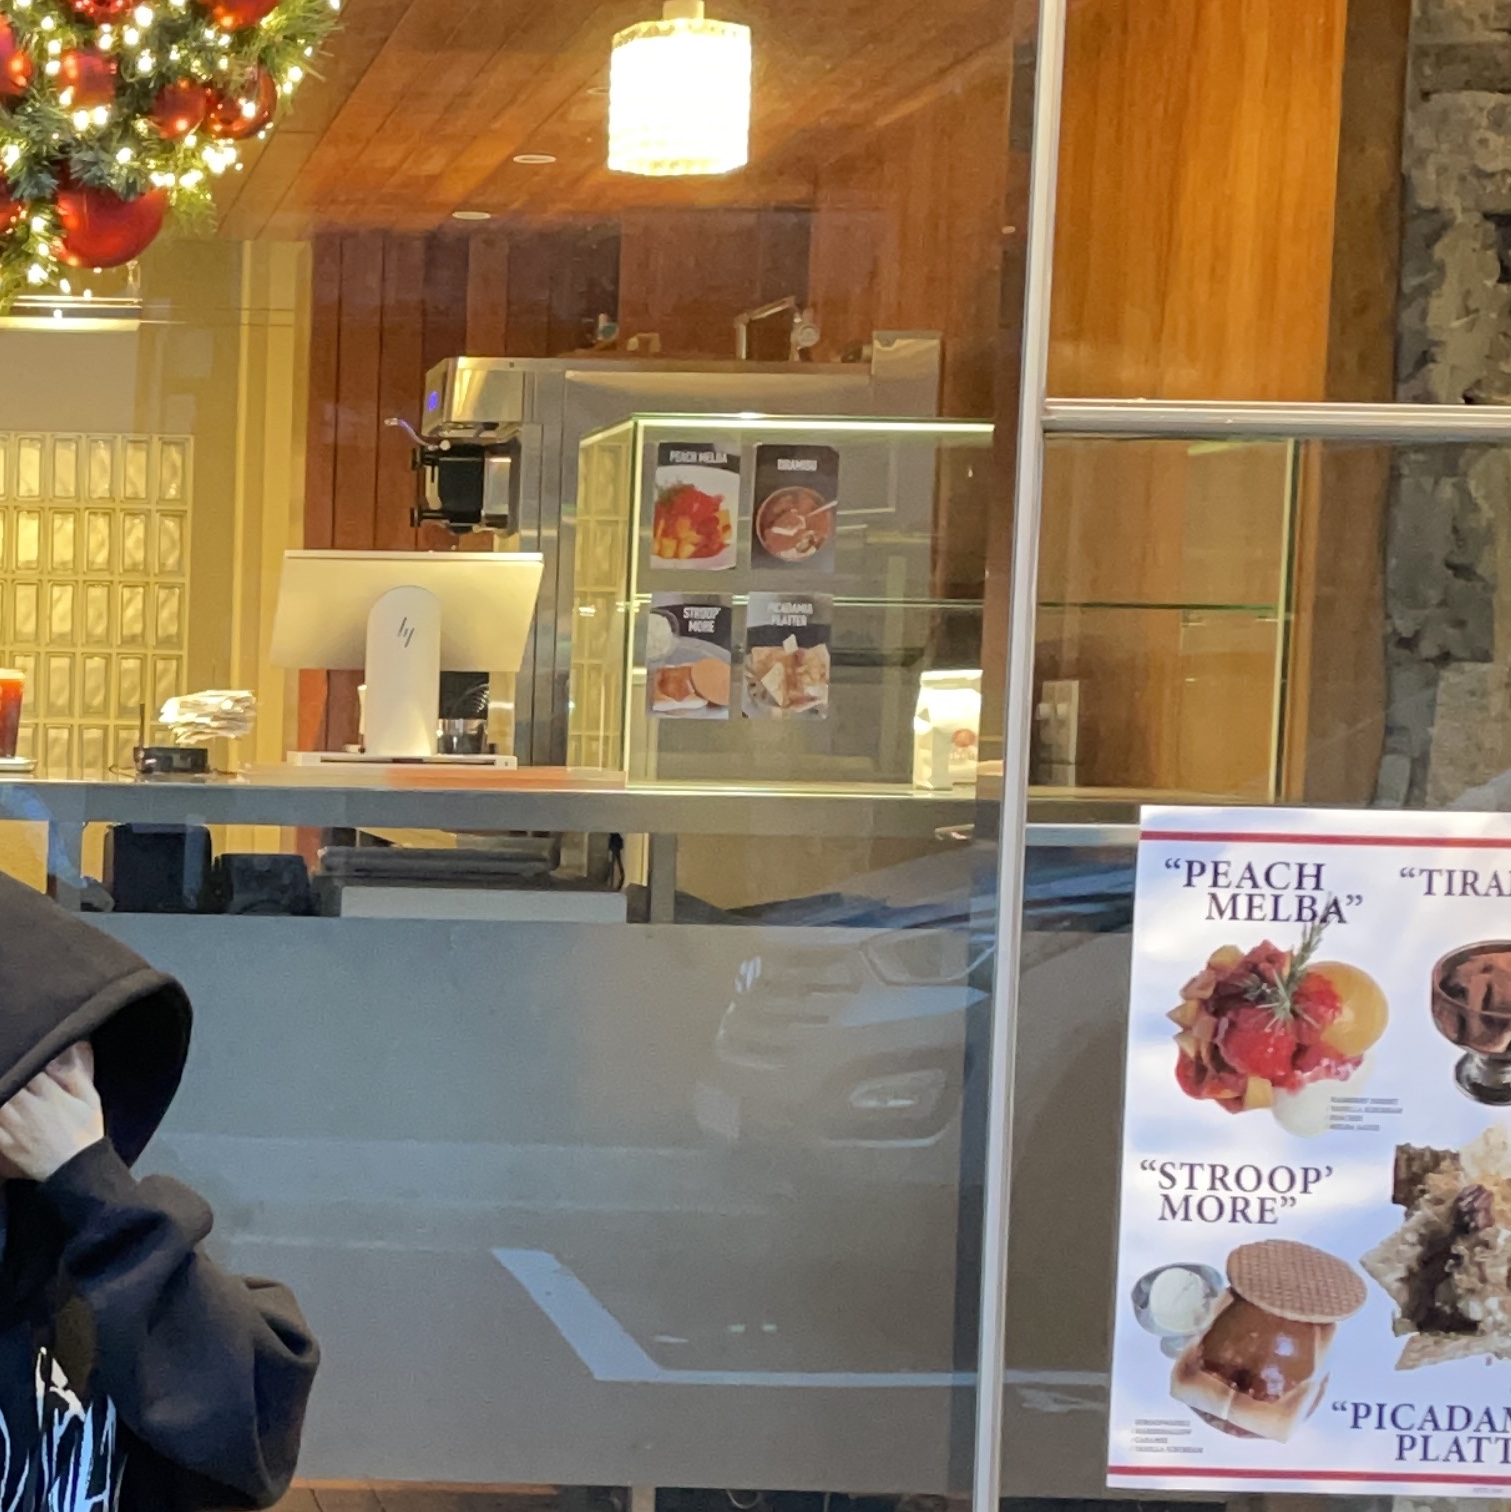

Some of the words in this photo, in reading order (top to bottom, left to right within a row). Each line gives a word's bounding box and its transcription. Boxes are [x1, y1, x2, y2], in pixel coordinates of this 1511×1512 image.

[1164, 857, 1326, 891] “PEACH
[1399, 866, 1511, 897] “TIRA
[1205, 892, 1363, 924] MELBA”
[1158, 1193, 1297, 1225] MORE”
